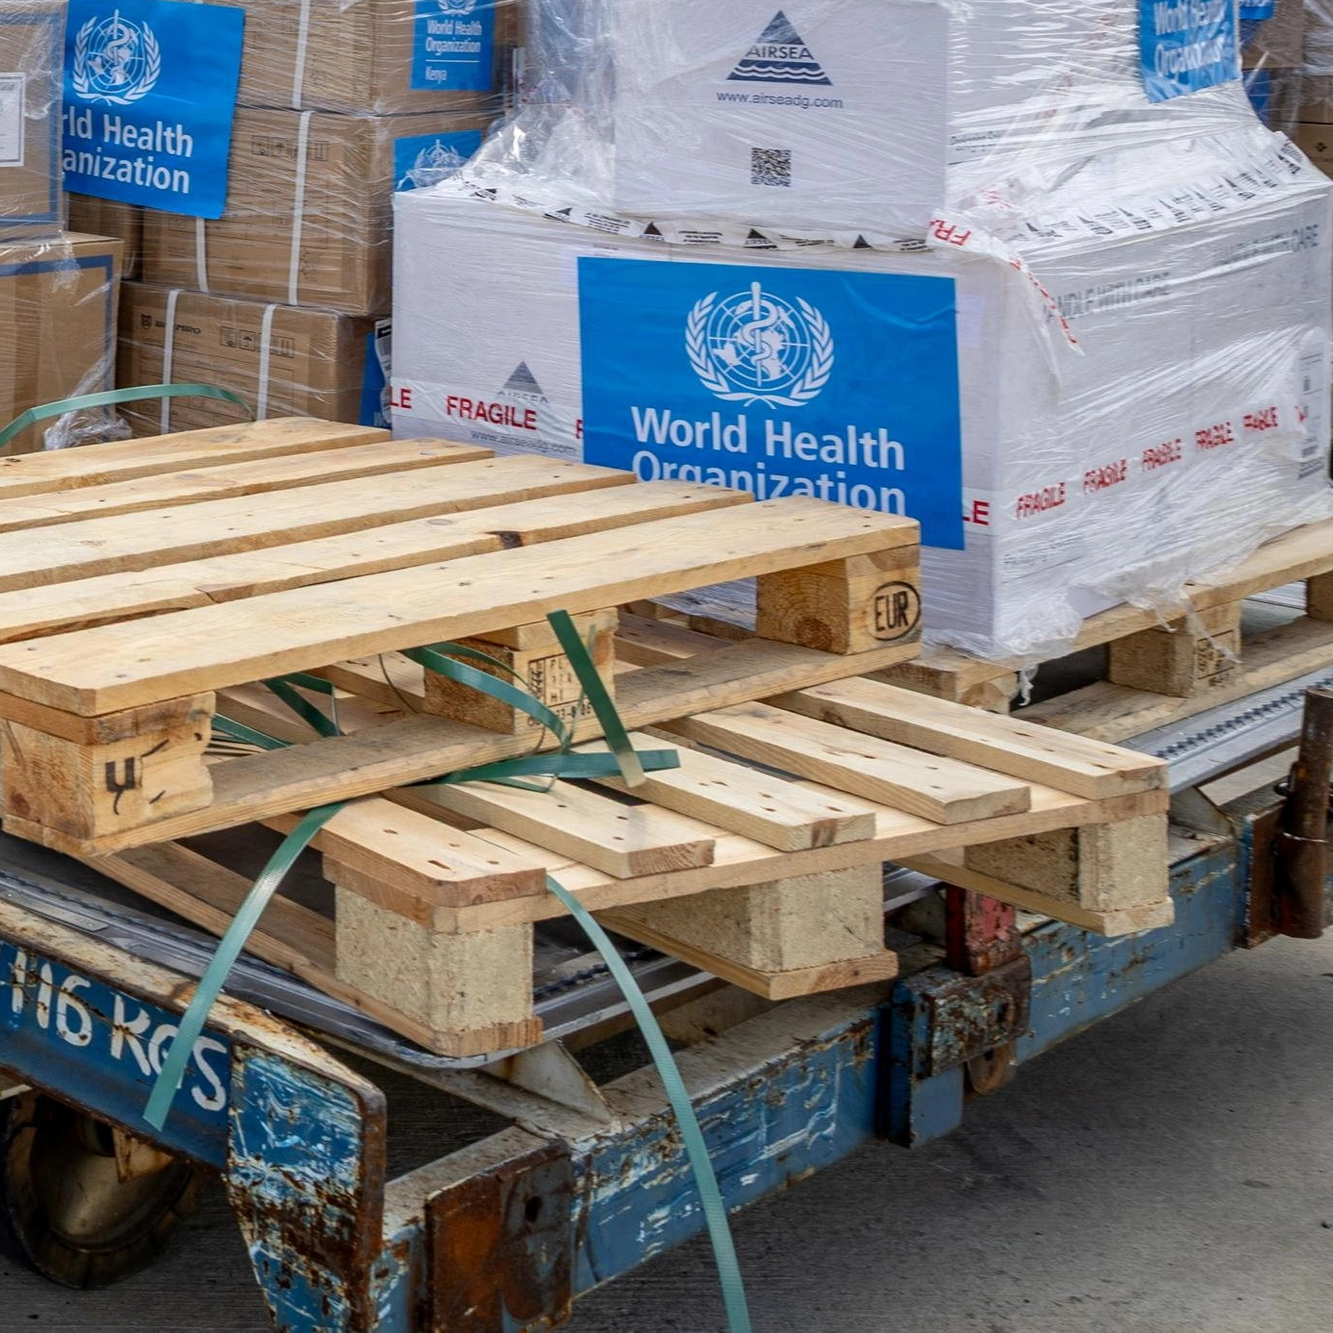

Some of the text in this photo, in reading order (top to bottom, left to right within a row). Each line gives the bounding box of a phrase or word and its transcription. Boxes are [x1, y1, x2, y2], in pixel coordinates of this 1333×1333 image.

[427, 19, 483, 36] World Health
[425, 37, 482, 56] Organization
[744, 46, 815, 60] AIRSEA
[716, 92, 844, 109] www.airseadg.com
[102, 113, 194, 158] Health
[63, 146, 190, 195] anization
[446, 395, 538, 430] FRAGILE
[631, 406, 747, 453] World
[765, 419, 905, 471] Health
[1016, 482, 1066, 520] FRAGILE
[874, 590, 909, 632] EUR
